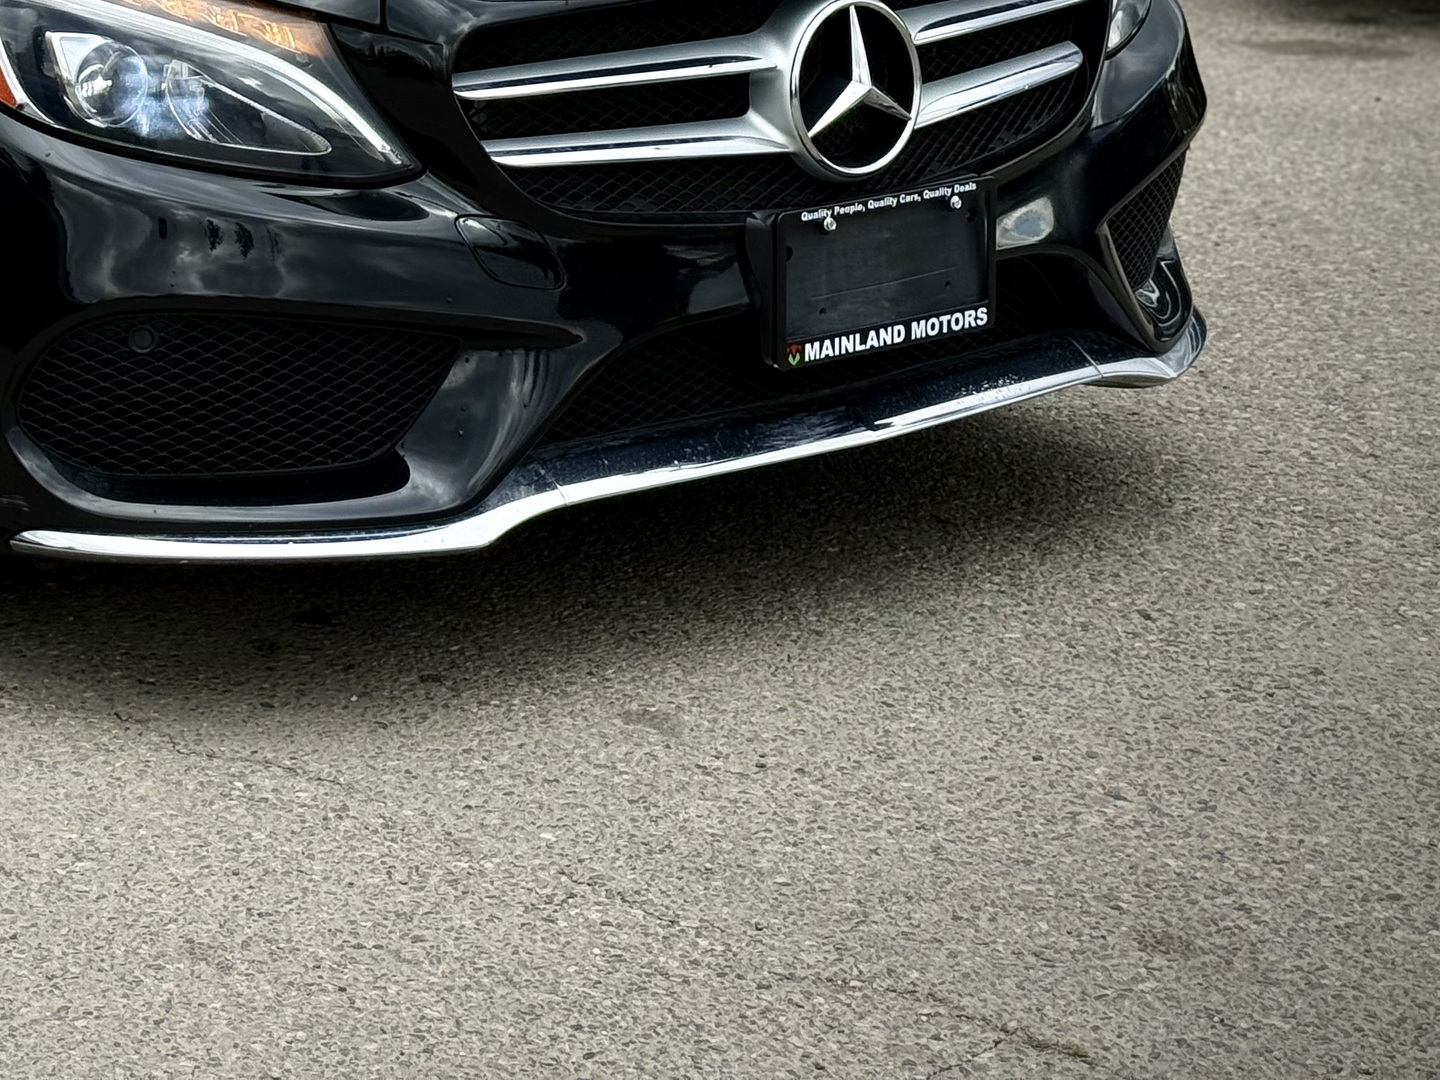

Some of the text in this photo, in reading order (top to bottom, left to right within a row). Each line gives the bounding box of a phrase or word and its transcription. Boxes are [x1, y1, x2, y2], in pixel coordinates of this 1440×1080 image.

[801, 181, 977, 222] Quality People, Quality Cars, Quality Deals
[804, 307, 989, 362] MAINLAND MOTORS
